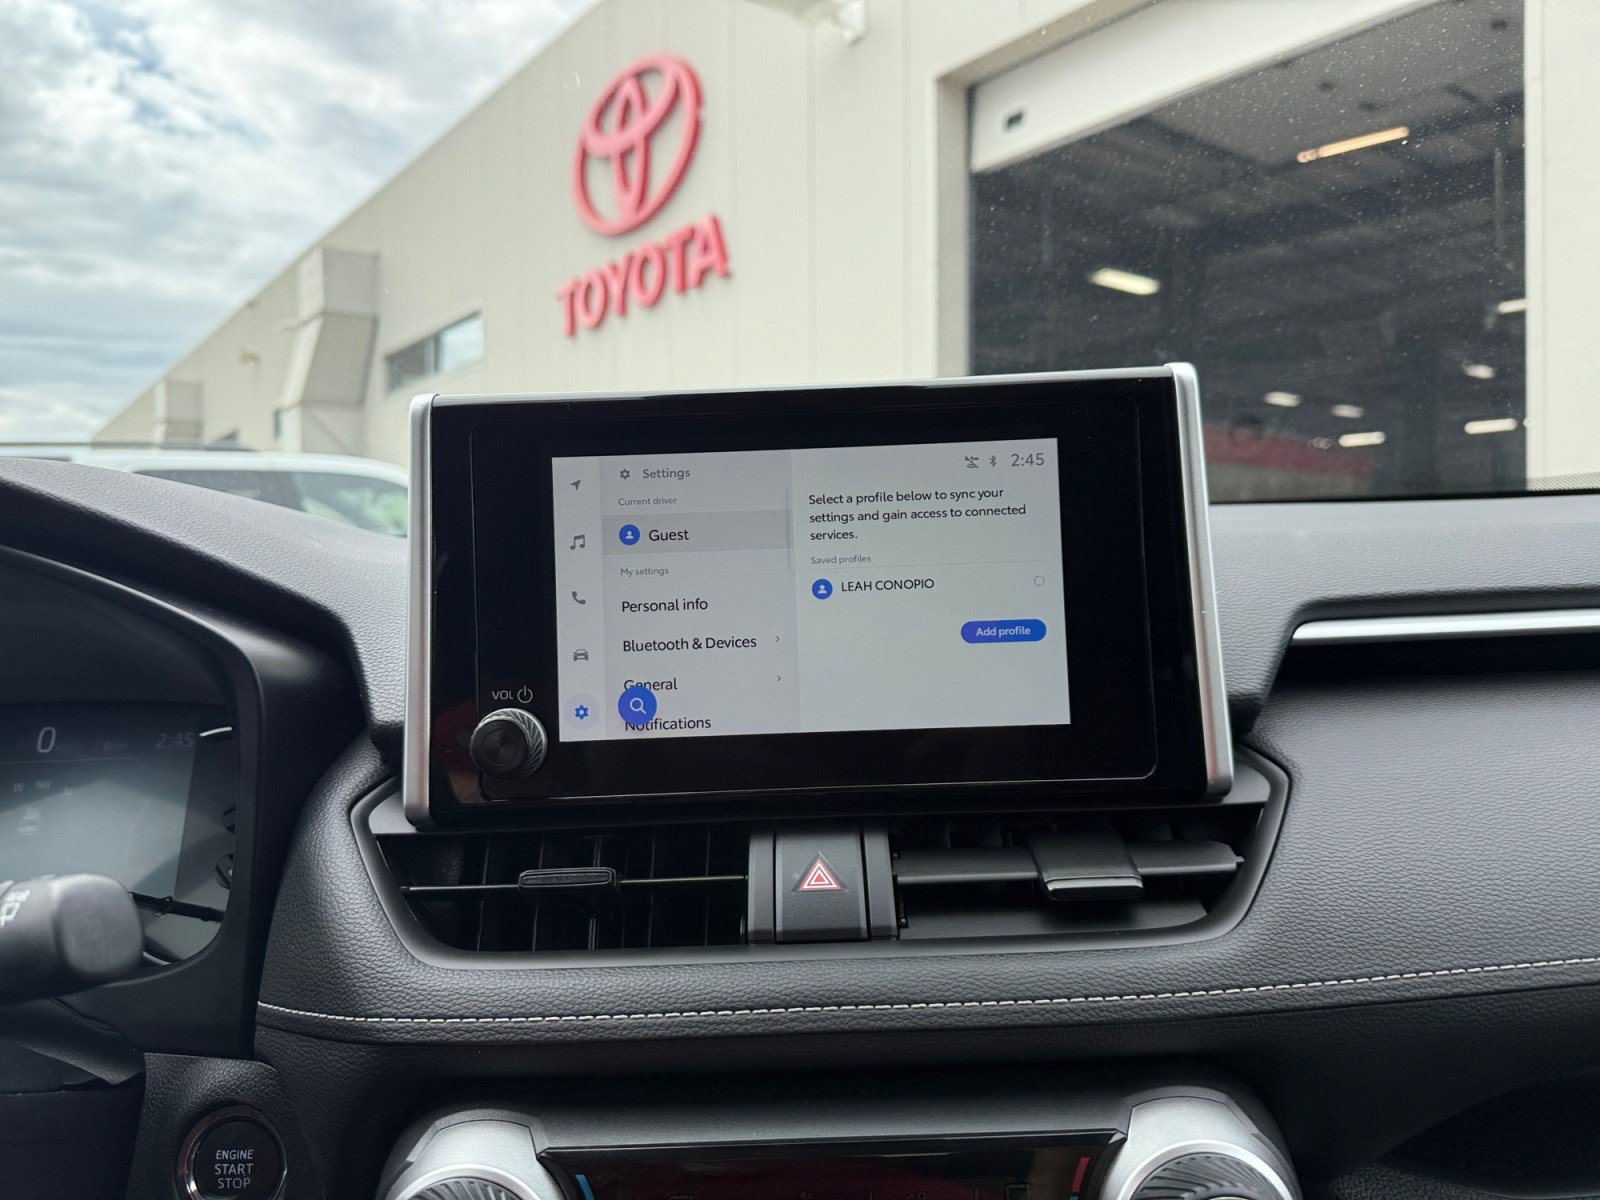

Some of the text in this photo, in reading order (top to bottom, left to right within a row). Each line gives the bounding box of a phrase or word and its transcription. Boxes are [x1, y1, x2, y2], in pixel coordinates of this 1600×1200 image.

[556, 212, 731, 339] TOYOTA
[1010, 453, 1045, 467] 2:45
[642, 468, 691, 480] Settings
[618, 496, 677, 506] Current driver
[808, 488, 1004, 505] Select a profile below to sync your
[809, 505, 1026, 525] settings and gain access to connected
[648, 529, 690, 541] Guest
[810, 530, 858, 541] services.
[811, 555, 871, 566] Saved profiles
[620, 566, 670, 577] My settings
[841, 578, 935, 592] LEAH CONOPIO
[622, 598, 709, 612] Personal info
[976, 625, 1031, 638] Add profile
[622, 636, 757, 652] Bluetooth & Devices
[491, 690, 514, 700] VOL
[37, 726, 56, 753] 0
[215, 1149, 254, 1160] ENGINE
[214, 1163, 254, 1176] START
[218, 1178, 251, 1189] STOP
